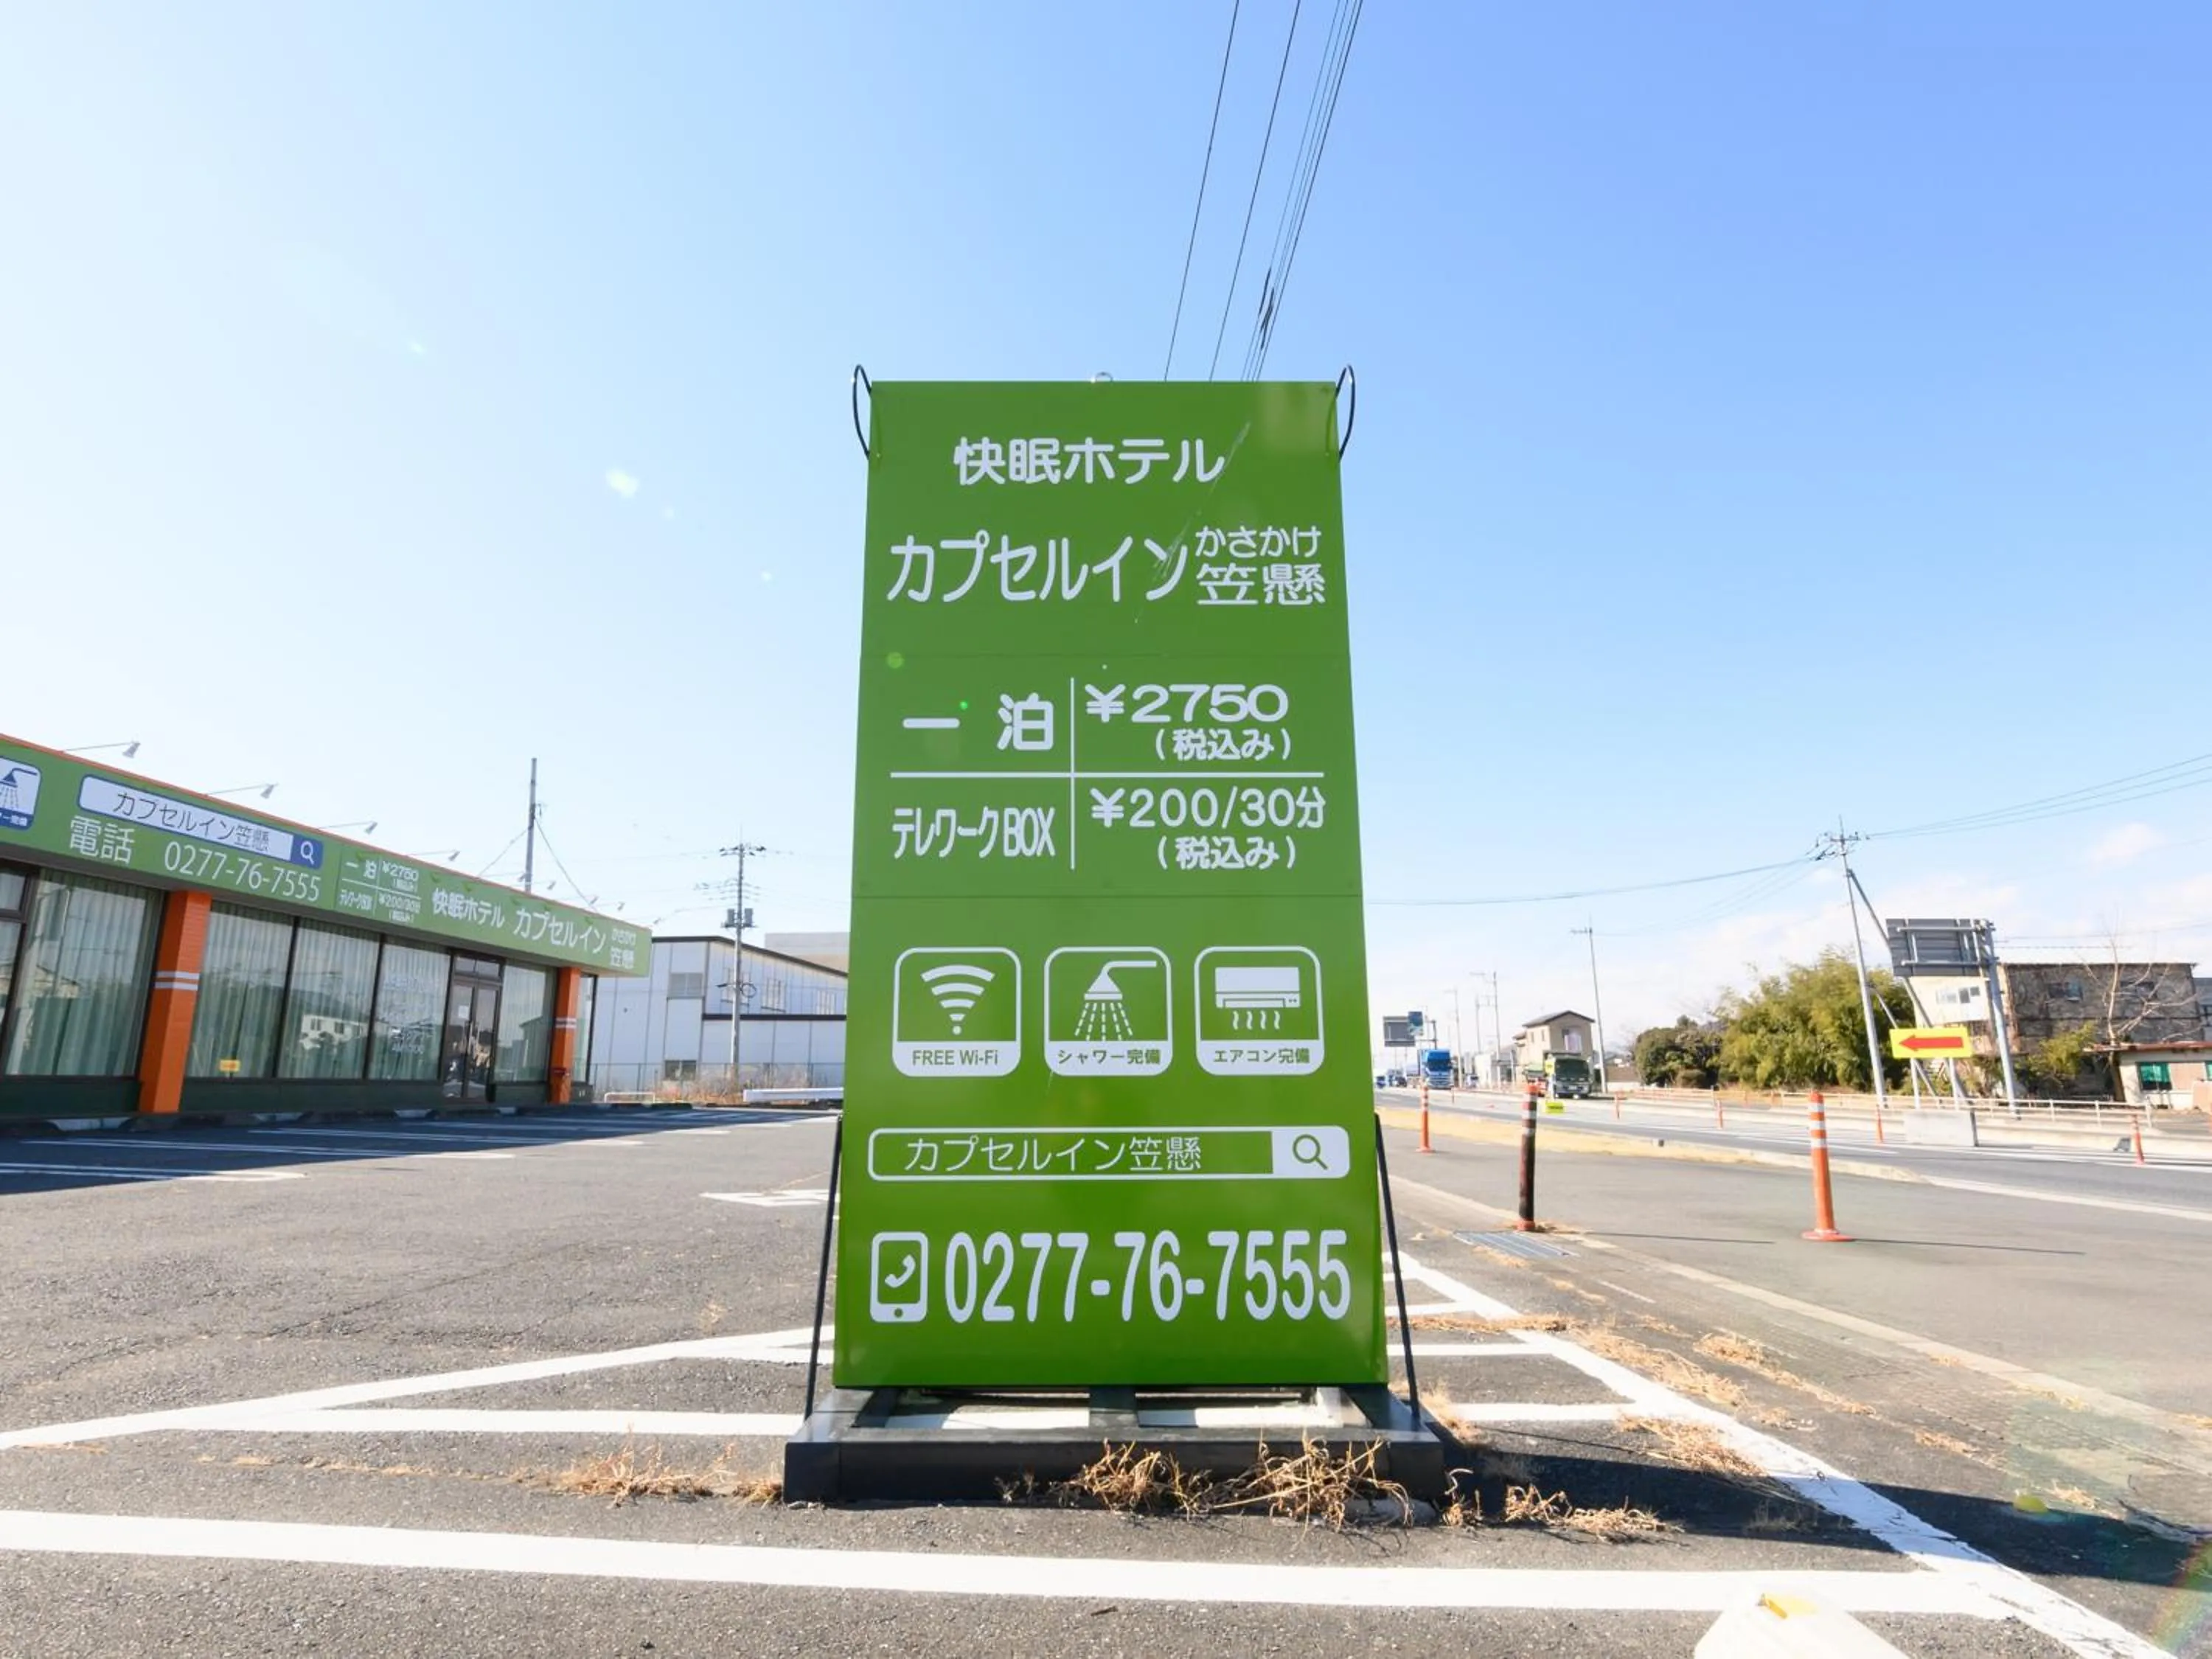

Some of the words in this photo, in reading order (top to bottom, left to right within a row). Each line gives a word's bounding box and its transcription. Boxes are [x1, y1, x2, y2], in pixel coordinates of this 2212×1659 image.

[953, 436, 1225, 486] 快眠ホテル
[1195, 525, 1322, 558] かさかけ
[887, 529, 1188, 603] カプセルイン
[1195, 563, 1326, 605] 笠懸
[1085, 684, 1290, 724] ¥2750
[1155, 728, 1292, 762] (税込み)
[1089, 785, 1326, 830] ¥200/30分
[891, 805, 1057, 859] テレワークBOX
[69, 815, 136, 865] 電話
[164, 841, 321, 903] 0277-76-7555
[1157, 835, 1297, 870] (税込み)
[431, 888, 505, 929] 快眠ホテル
[513, 908, 607, 955] カプセルイン
[912, 1050, 954, 1065] FREE
[959, 1049, 998, 1065] Wi-Fi
[1058, 1049, 1161, 1065] シャワー完備
[1214, 1048, 1310, 1064] エアコン完備
[905, 1135, 1201, 1172] カプセルイン笠懸
[945, 1229, 1352, 1324] 0277-76-7555
